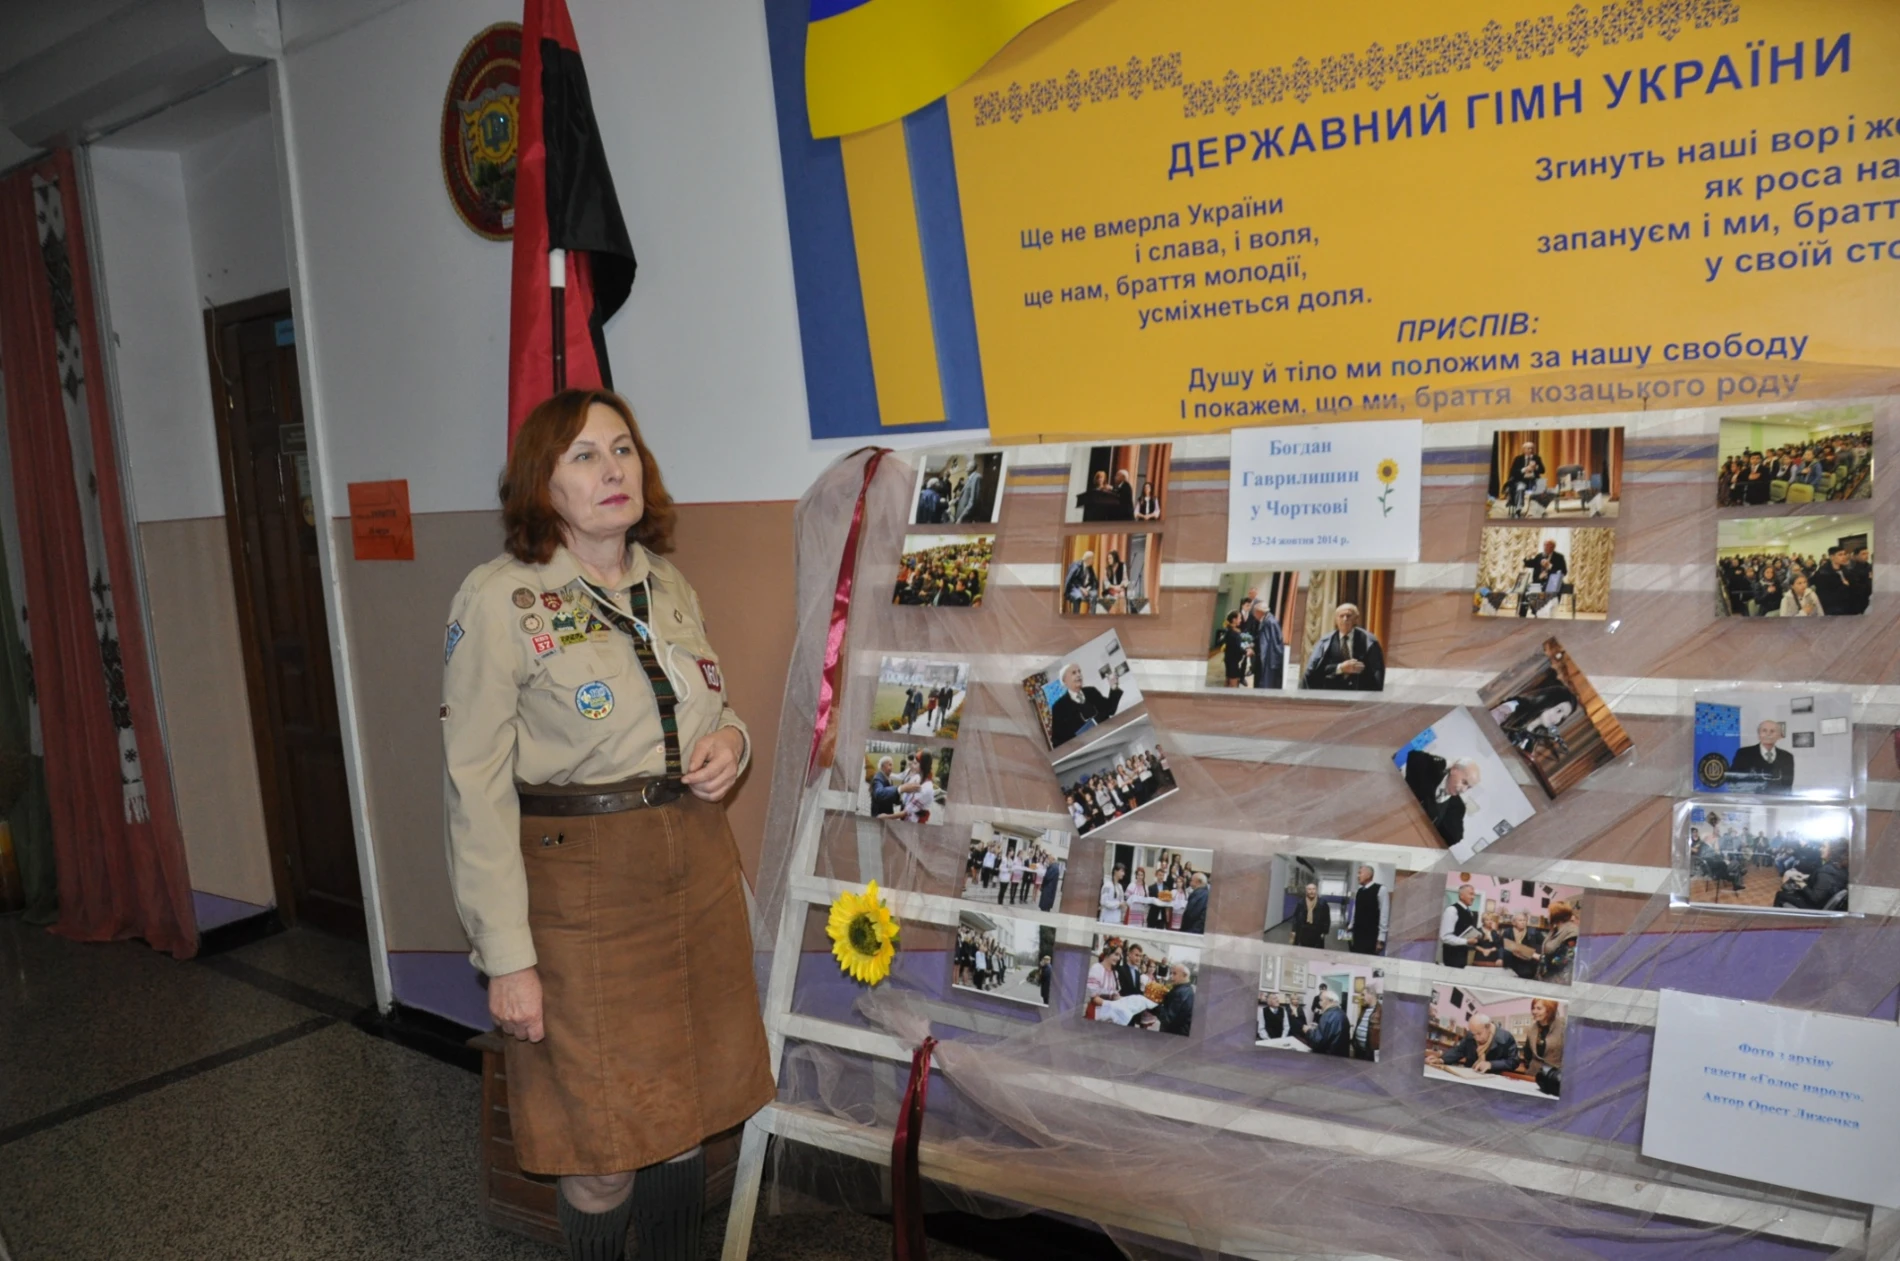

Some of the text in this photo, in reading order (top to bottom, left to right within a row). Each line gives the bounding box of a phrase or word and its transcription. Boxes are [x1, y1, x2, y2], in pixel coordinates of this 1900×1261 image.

[1168, 33, 1852, 180] ДЕРЖАВНИЙ ГІМН УКРАЇНИ
[1535, 149, 1665, 181] Згинуть
[1677, 131, 1757, 165] наші
[1705, 177, 1743, 199] як
[1756, 166, 1842, 199] роса
[1020, 196, 1284, 249] Ще не вмерла України
[1537, 223, 1690, 253] запануєм
[1703, 214, 1709, 237] і
[1724, 213, 1780, 236] ми,
[1135, 227, 1320, 263] і слава, і воля,
[1706, 255, 1723, 281] у
[1735, 239, 1832, 273] своїй
[1024, 255, 1307, 308] ще нам, браття молодії,
[1138, 287, 1372, 329] усміхнеться доля.
[1396, 312, 1539, 343] ПРИСПІВ:
[1188, 332, 1809, 392] Душу й тіло ми положим за нашу свободу
[1180, 400, 1187, 419] І
[1316, 394, 1353, 414] що
[1363, 394, 1406, 412] ми,
[1415, 386, 1511, 413] браття
[1530, 380, 1705, 405] козацького
[1717, 372, 1801, 401] роду
[1269, 439, 1332, 456] Богдан
[1242, 470, 1360, 490] Гаврилишин
[1251, 498, 1348, 520] у Чорткові
[1251, 536, 1276, 546] 23-24
[1317, 534, 1338, 545] 2014
[1340, 534, 1350, 546] р.
[1738, 1043, 1775, 1058] Фото
[1703, 1065, 1746, 1081] газети
[1703, 1091, 1746, 1110] Автор
[1748, 1099, 1790, 1117] Орест
